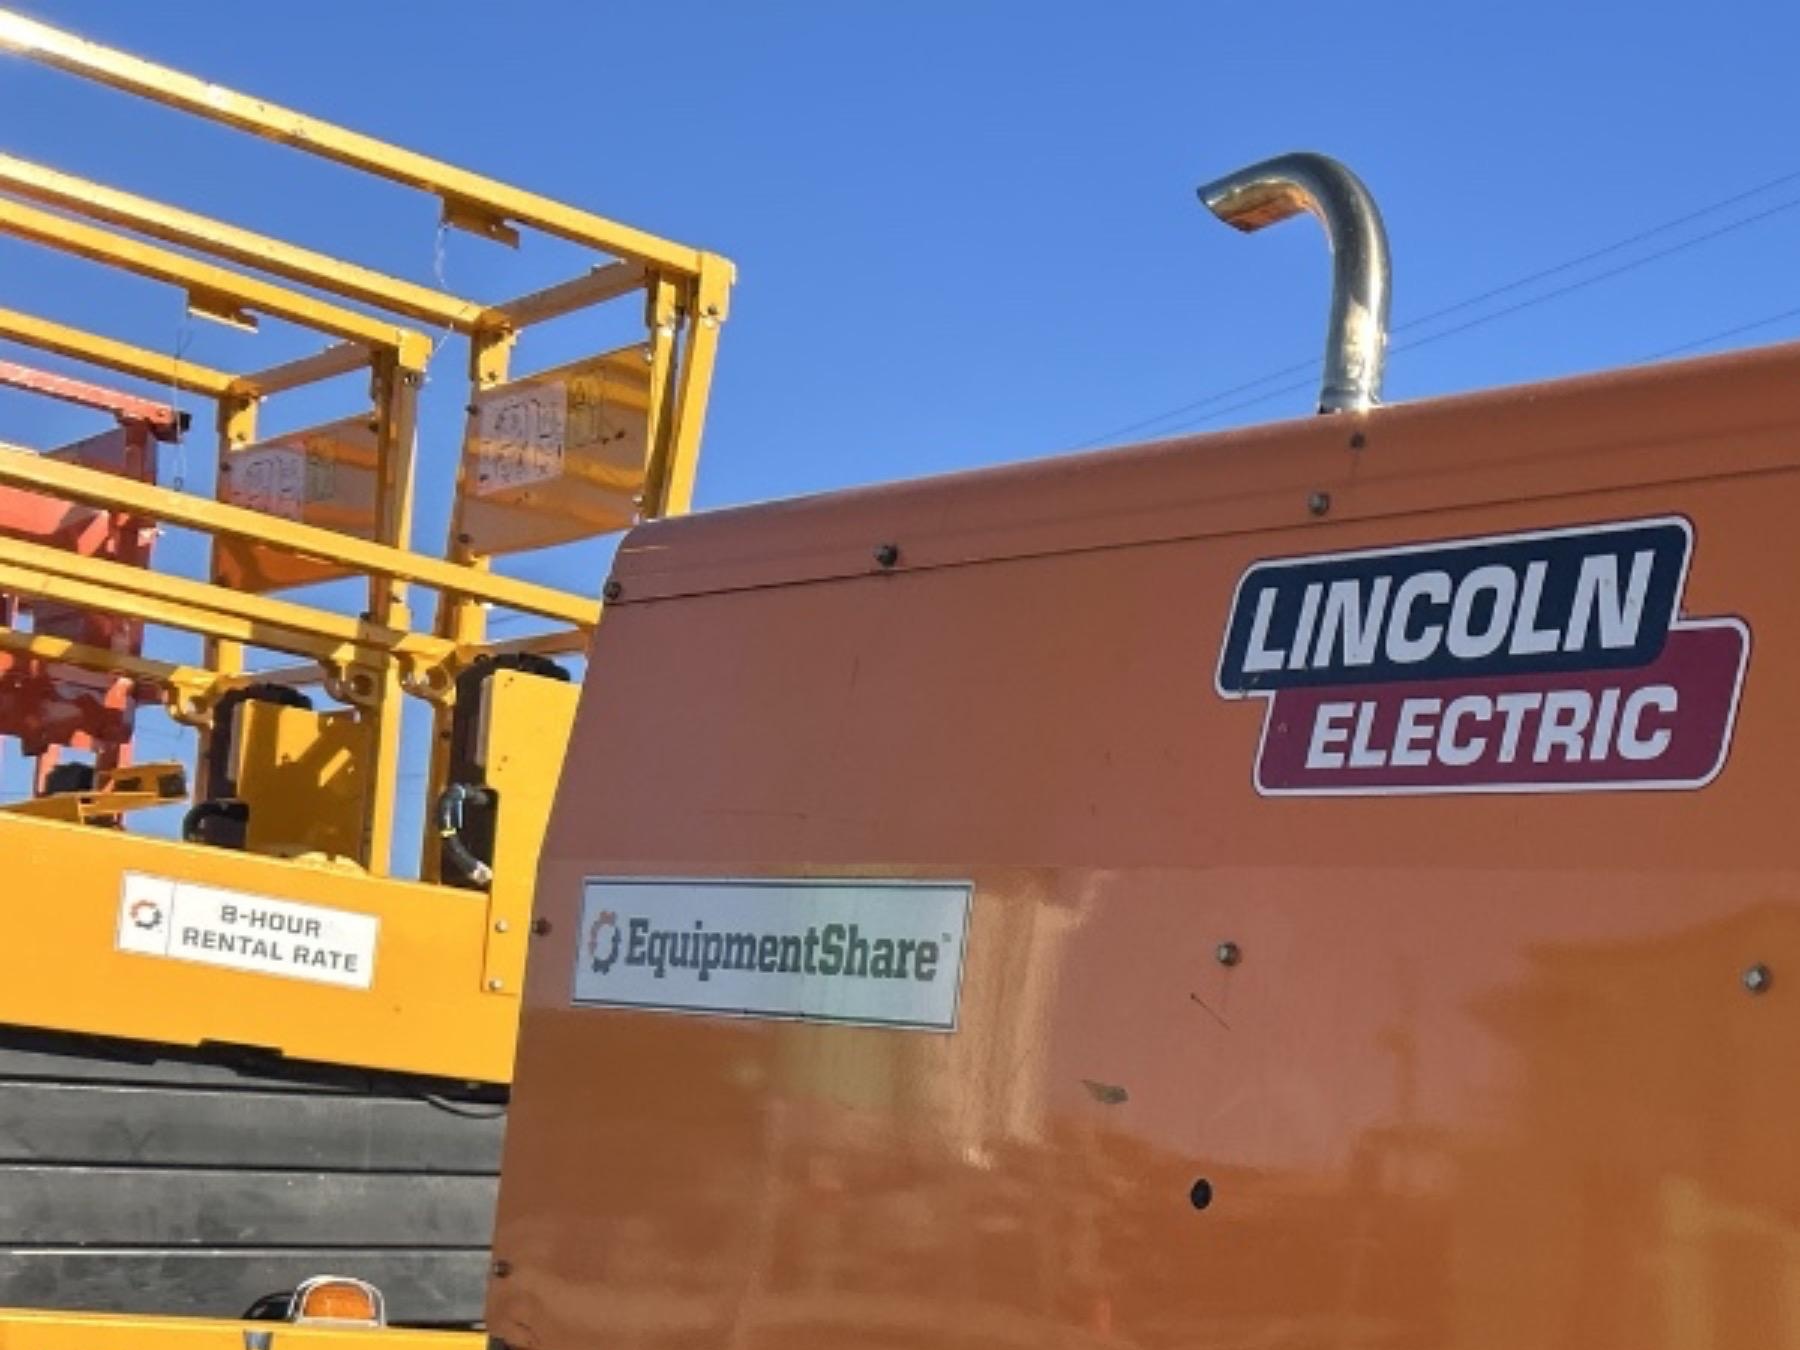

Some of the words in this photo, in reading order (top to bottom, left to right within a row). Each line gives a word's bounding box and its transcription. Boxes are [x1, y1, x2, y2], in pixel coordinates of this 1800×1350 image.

[1242, 550, 1655, 674] LINCOLN
[1305, 685, 1678, 769] ELECTRIC
[182, 927, 283, 961] RENTAL
[293, 945, 359, 973] RATE
[220, 905, 322, 938] 8-HOUR
[624, 917, 940, 982] EquipmentShare
